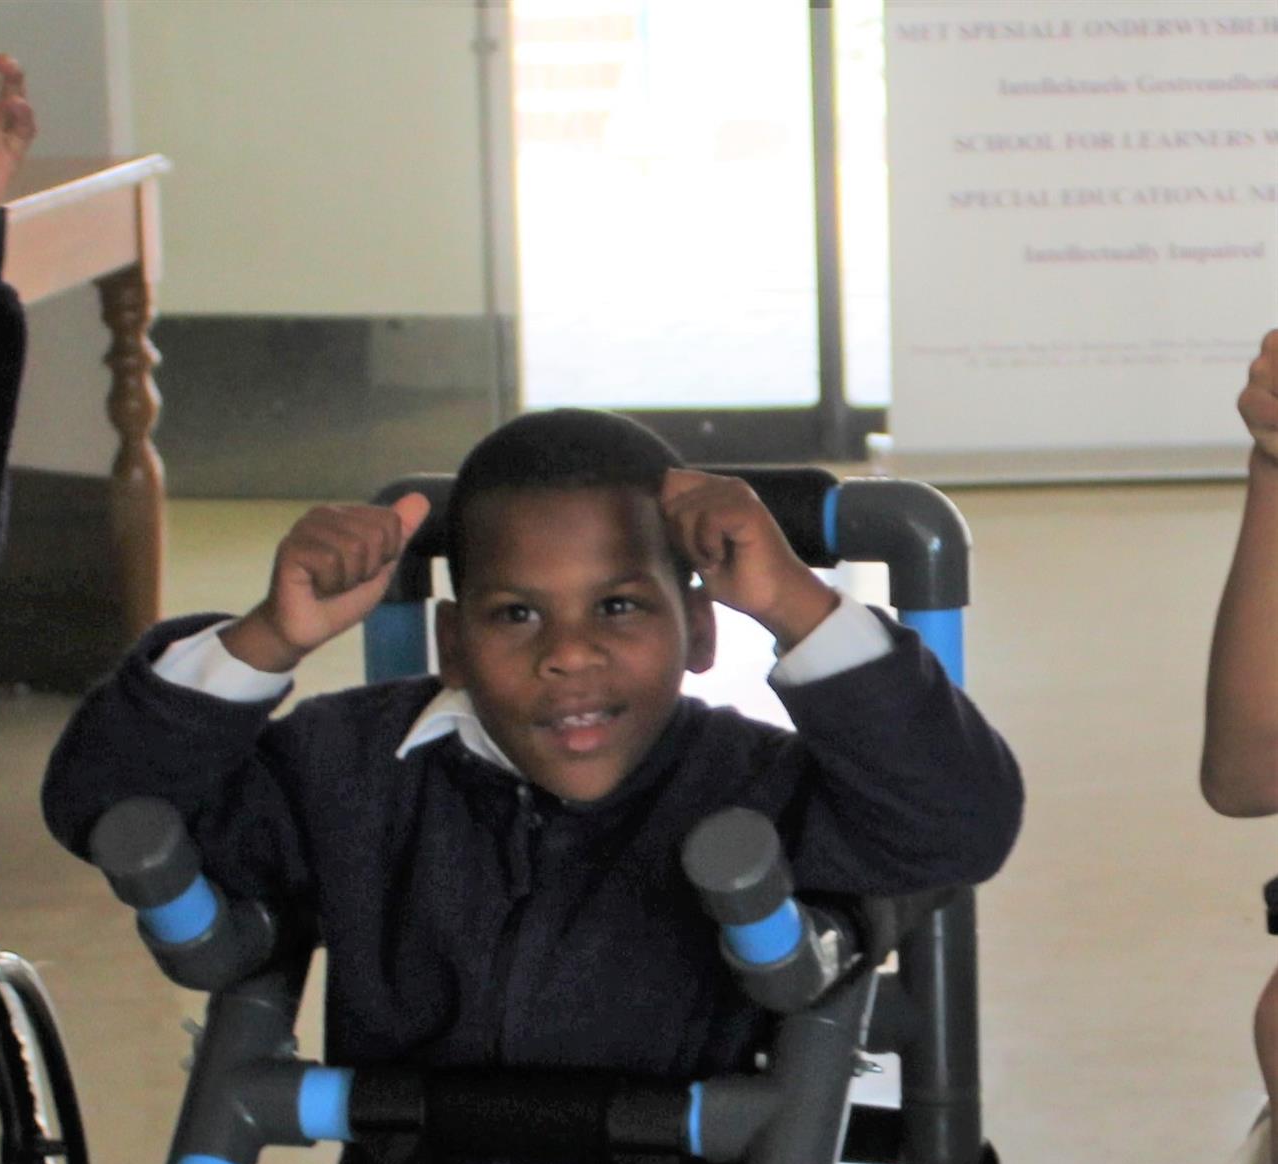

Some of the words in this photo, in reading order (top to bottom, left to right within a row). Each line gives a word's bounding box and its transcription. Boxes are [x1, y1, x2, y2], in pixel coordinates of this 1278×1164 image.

[953, 132, 1056, 153] SCHOOL
[1066, 131, 1115, 151] FOR
[1124, 129, 1256, 149] LEARNERS
[949, 190, 1050, 210] SPECIAL
[1060, 187, 1237, 207] EDUCATIONAL
